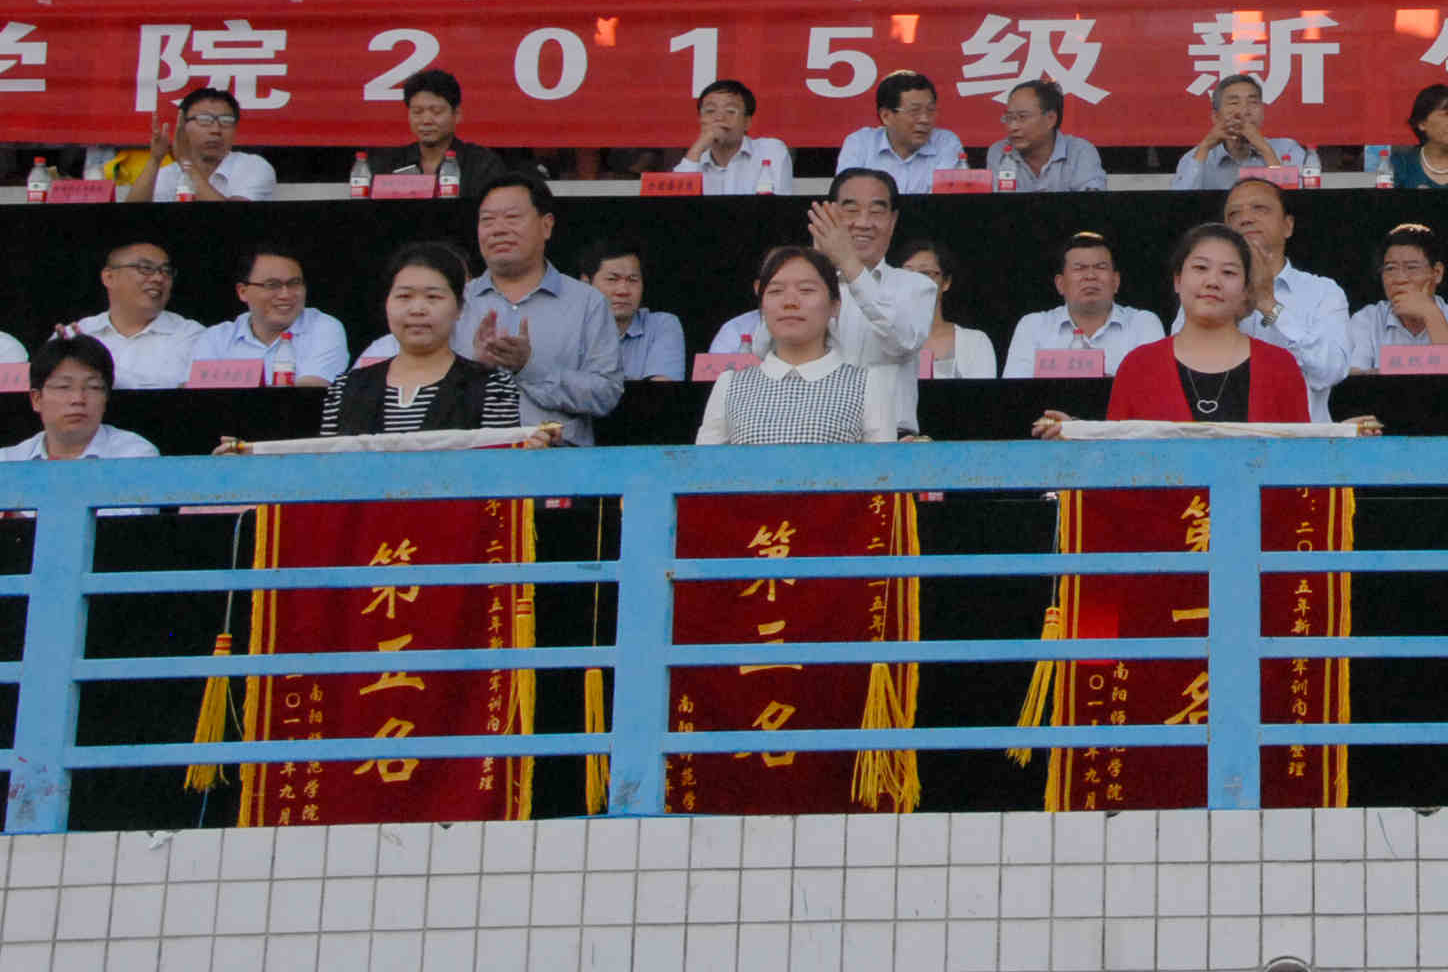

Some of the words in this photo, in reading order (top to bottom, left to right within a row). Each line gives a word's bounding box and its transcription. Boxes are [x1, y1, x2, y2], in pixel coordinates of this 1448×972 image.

[1105, 661, 1129, 802] 南阳师学院
